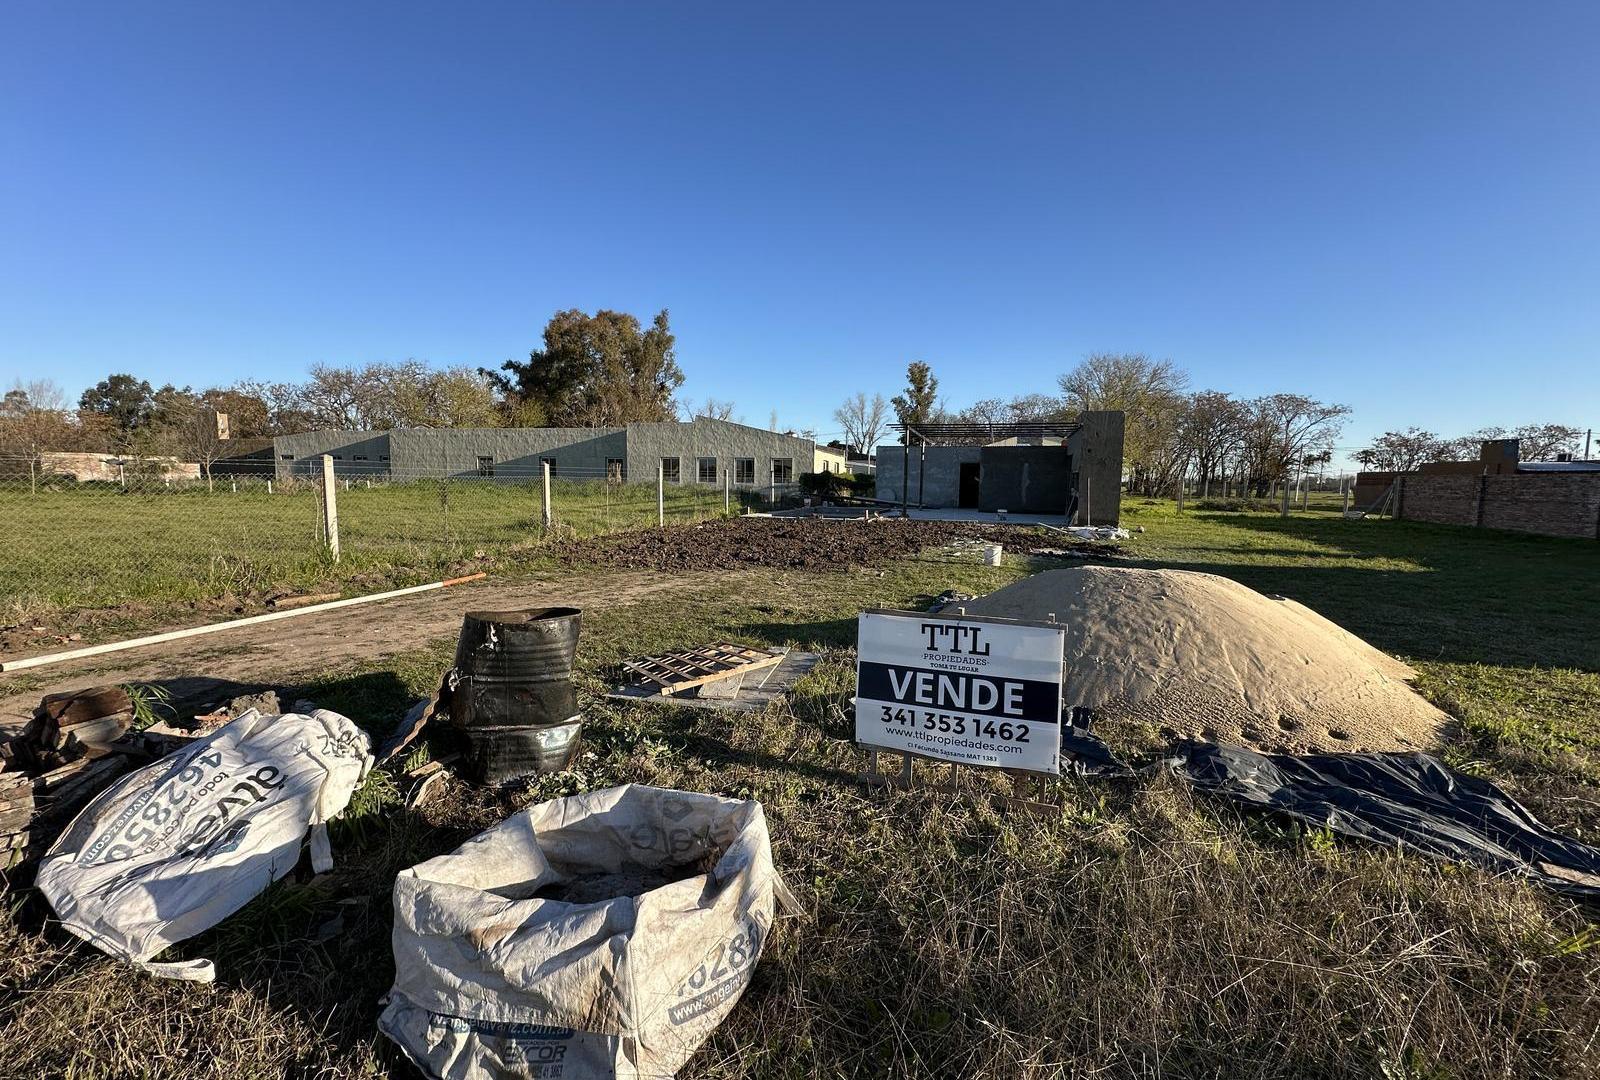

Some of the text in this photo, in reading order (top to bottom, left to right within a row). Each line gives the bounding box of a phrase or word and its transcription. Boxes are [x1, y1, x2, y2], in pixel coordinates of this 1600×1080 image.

[921, 623, 990, 656] TTL
[887, 668, 1024, 715] VENDE
[880, 705, 1030, 743] 341 353 1462
[885, 726, 1022, 754] www.ttlpropiedades.com
[966, 753, 981, 761] MAT
[198, 771, 230, 797] todo
[103, 751, 222, 862] 462850
